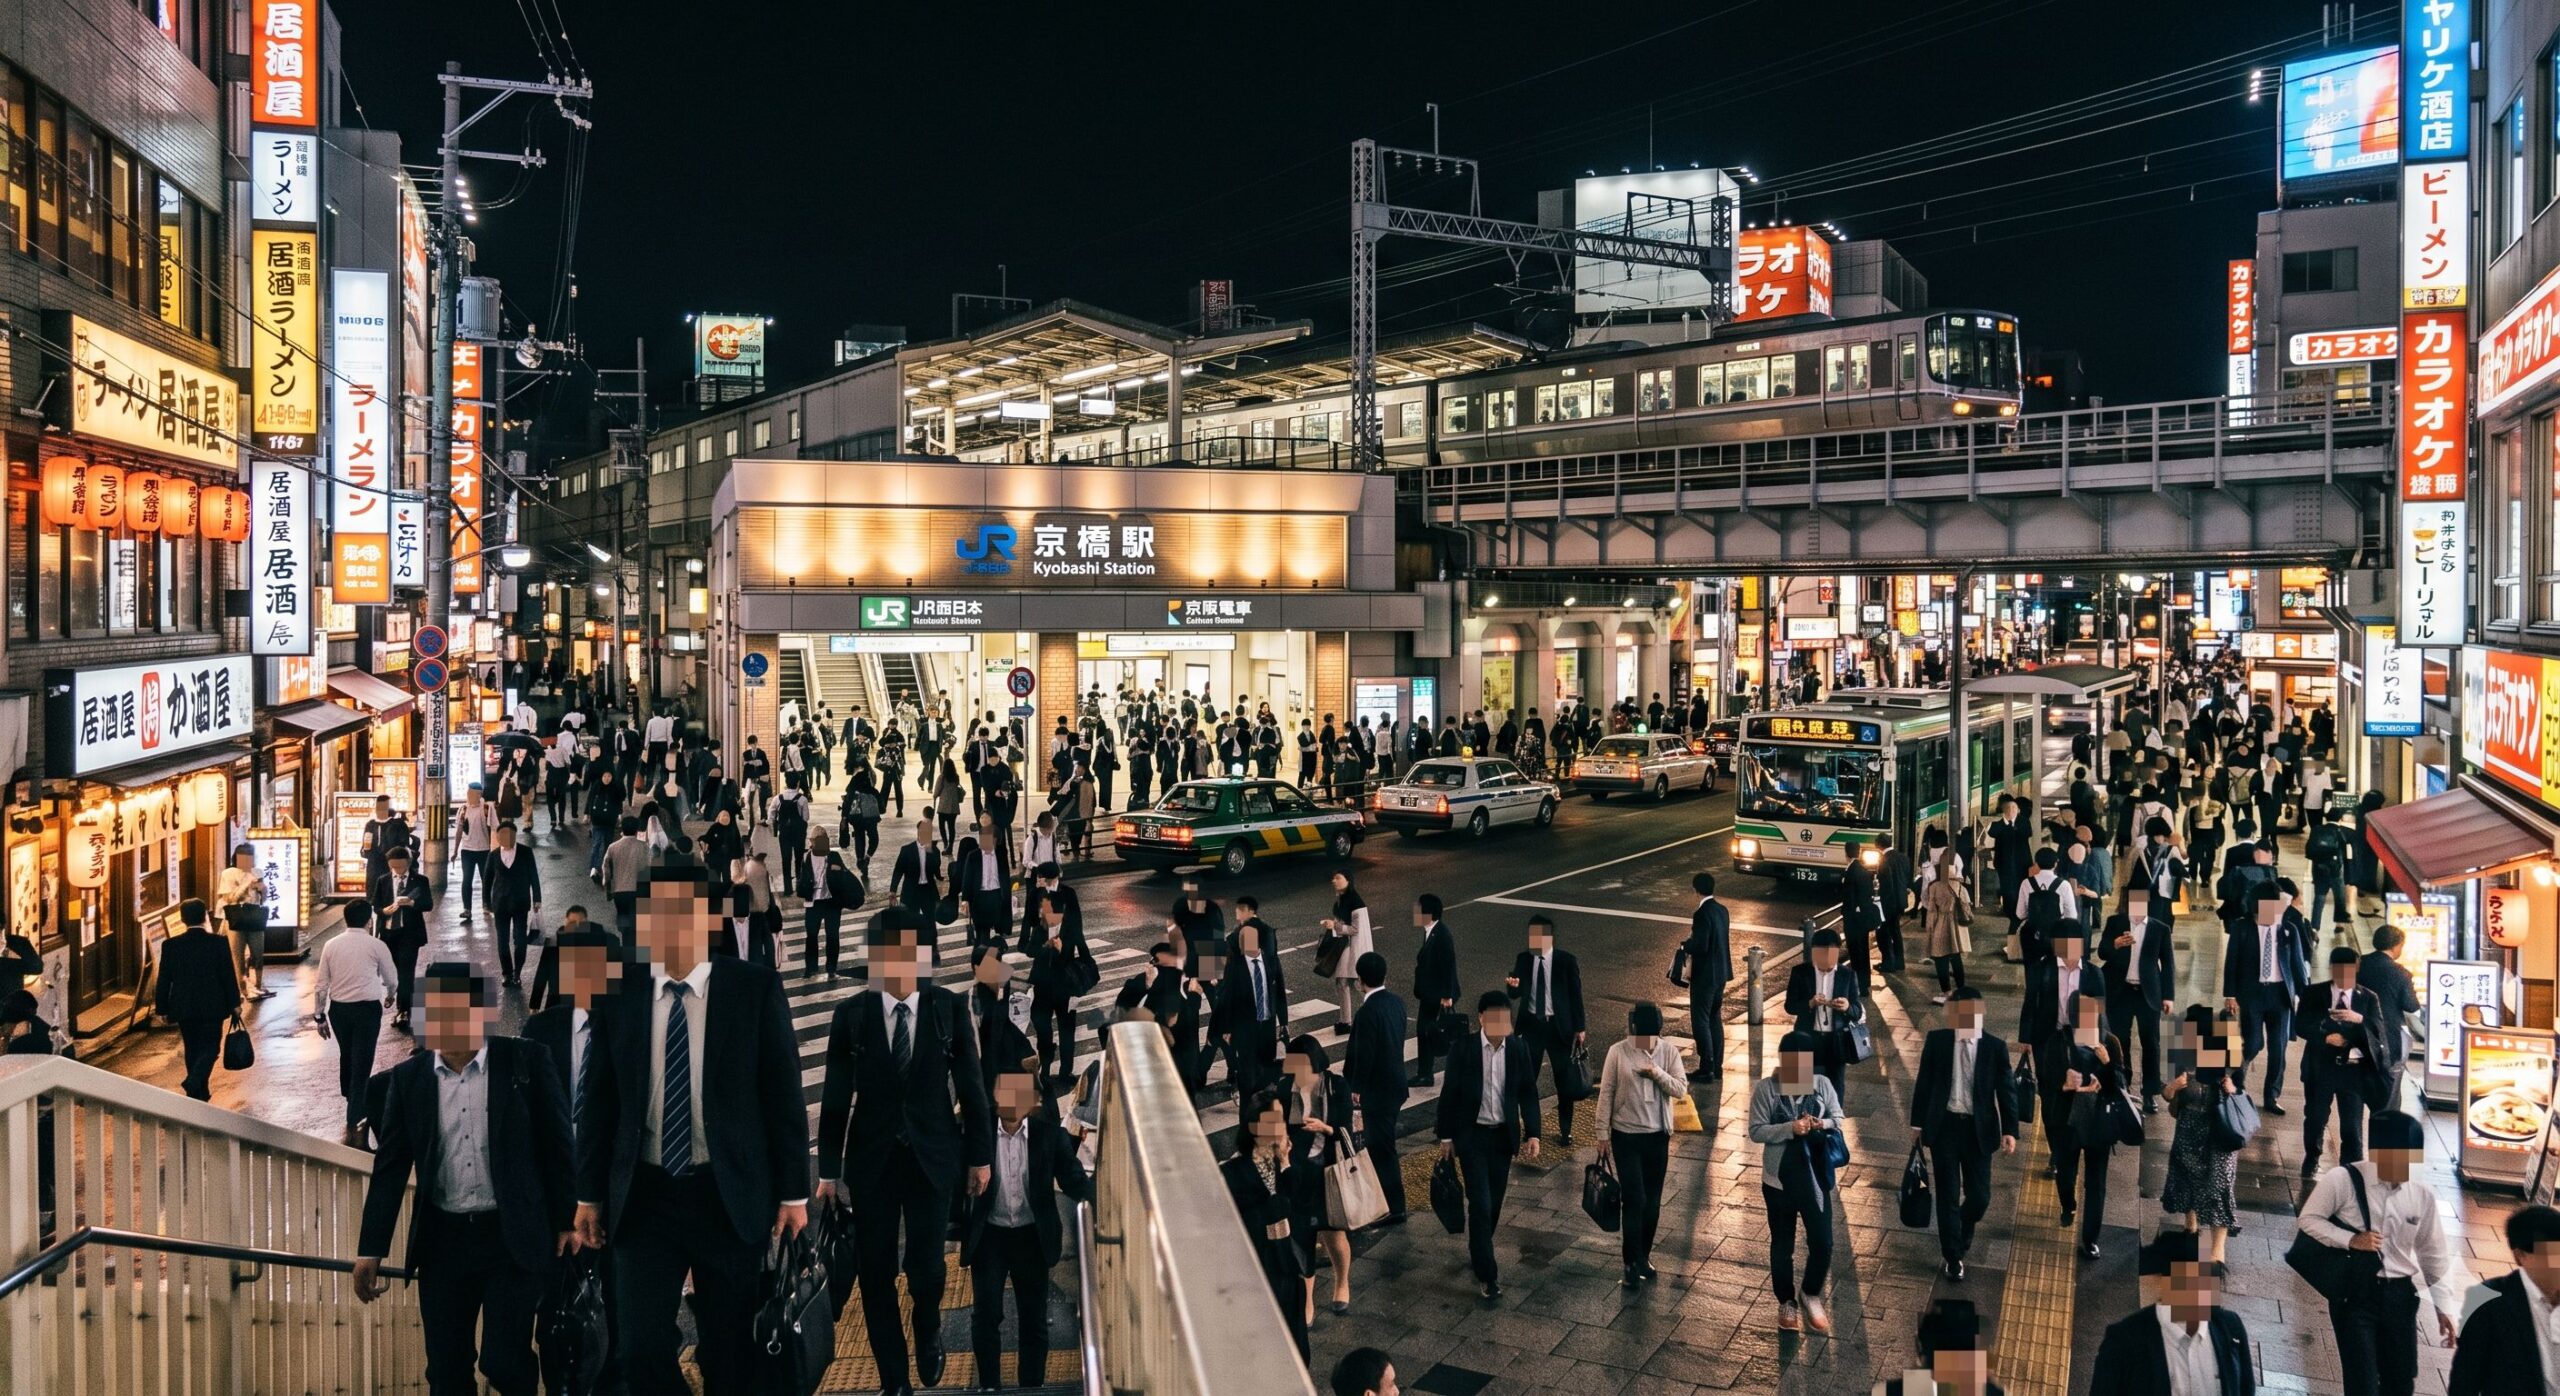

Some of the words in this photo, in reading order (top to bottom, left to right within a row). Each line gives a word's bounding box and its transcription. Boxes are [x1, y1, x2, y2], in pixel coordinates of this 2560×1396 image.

[264, 3, 304, 118] 居酒屋
[271, 140, 293, 215] ラーメン
[2412, 319, 2455, 470] カラオケ
[348, 383, 377, 516] ラーメラン
[956, 523, 1018, 561] JR
[1033, 524, 1156, 558] 京橋駅
[1033, 561, 1100, 578] Kyobashi
[1103, 561, 1156, 576] Station
[80, 690, 136, 746] 居酒屋
